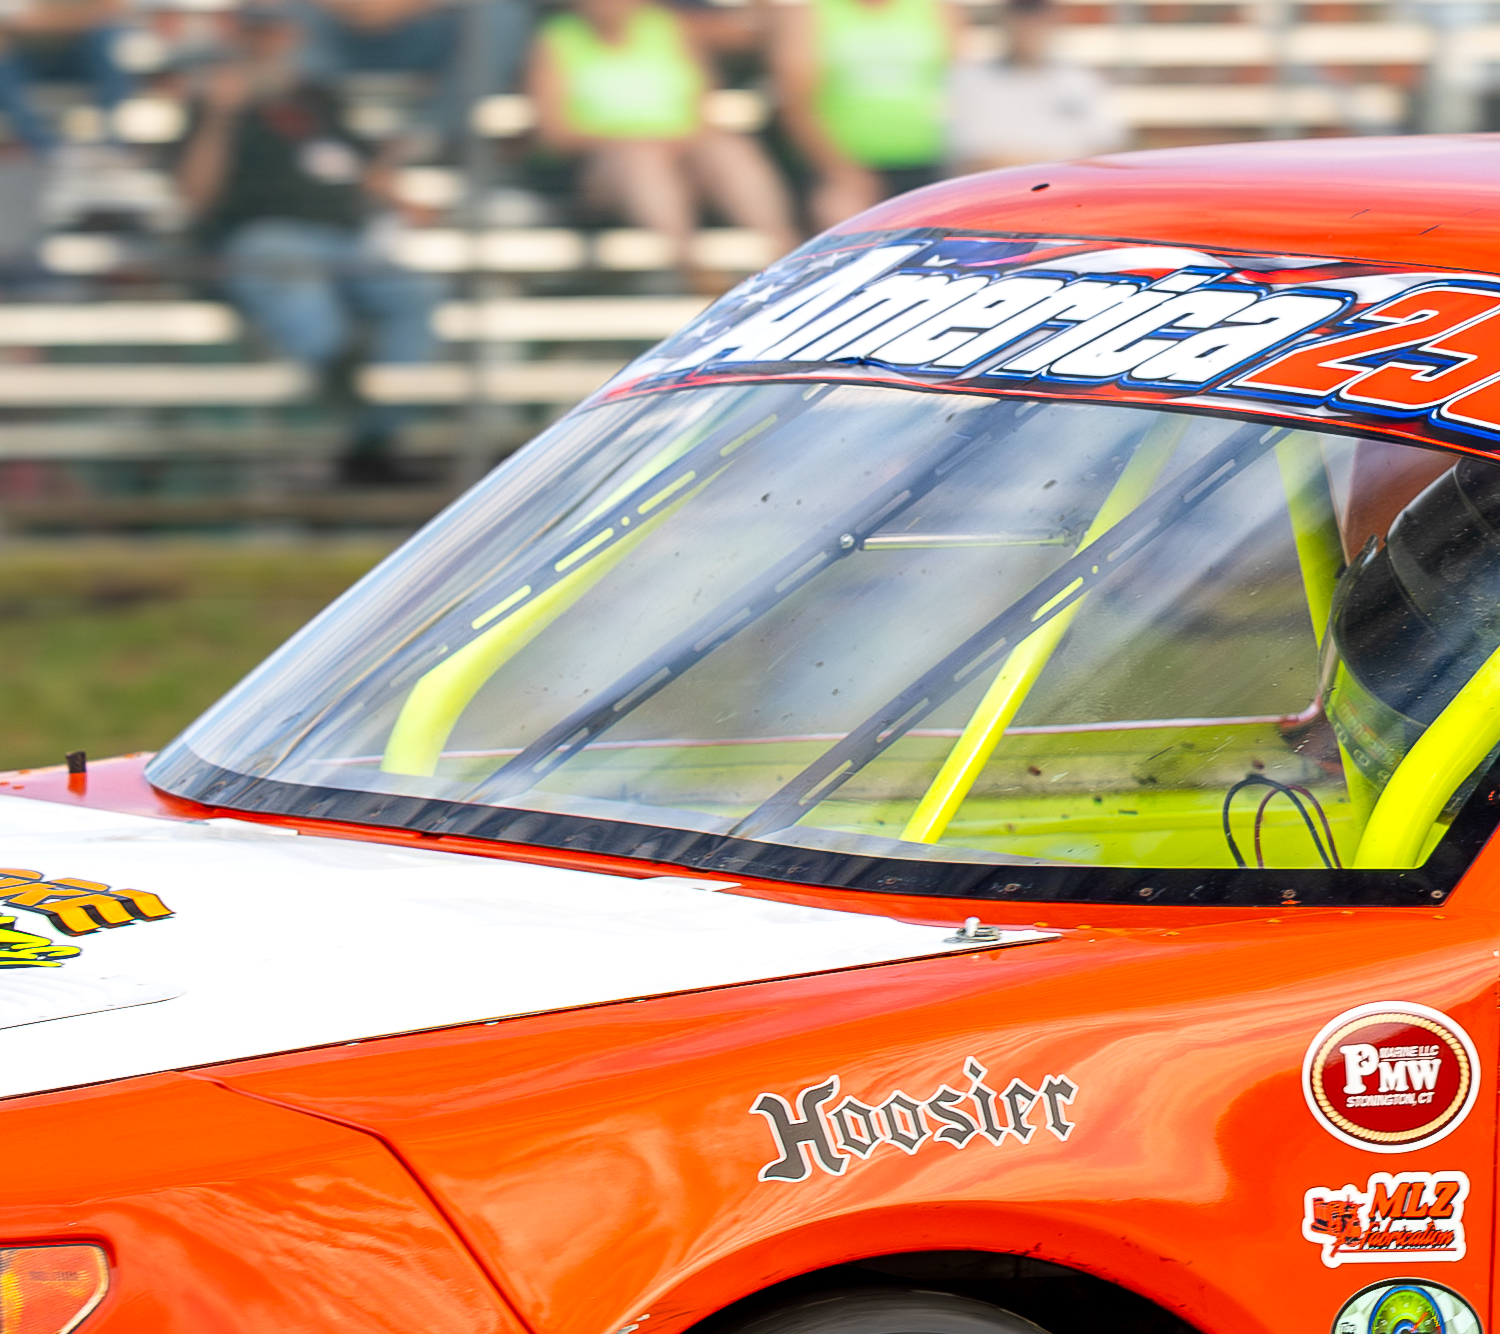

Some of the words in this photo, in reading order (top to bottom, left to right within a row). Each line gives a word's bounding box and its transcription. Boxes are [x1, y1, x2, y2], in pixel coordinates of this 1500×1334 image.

[660, 239, 1353, 386] America
[1339, 1043, 1442, 1095] PMW
[1419, 1044, 1441, 1057] LLC
[749, 1056, 1079, 1183] Hoosier
[1417, 1091, 1437, 1105] CT
[1369, 1180, 1461, 1221] MLZ
